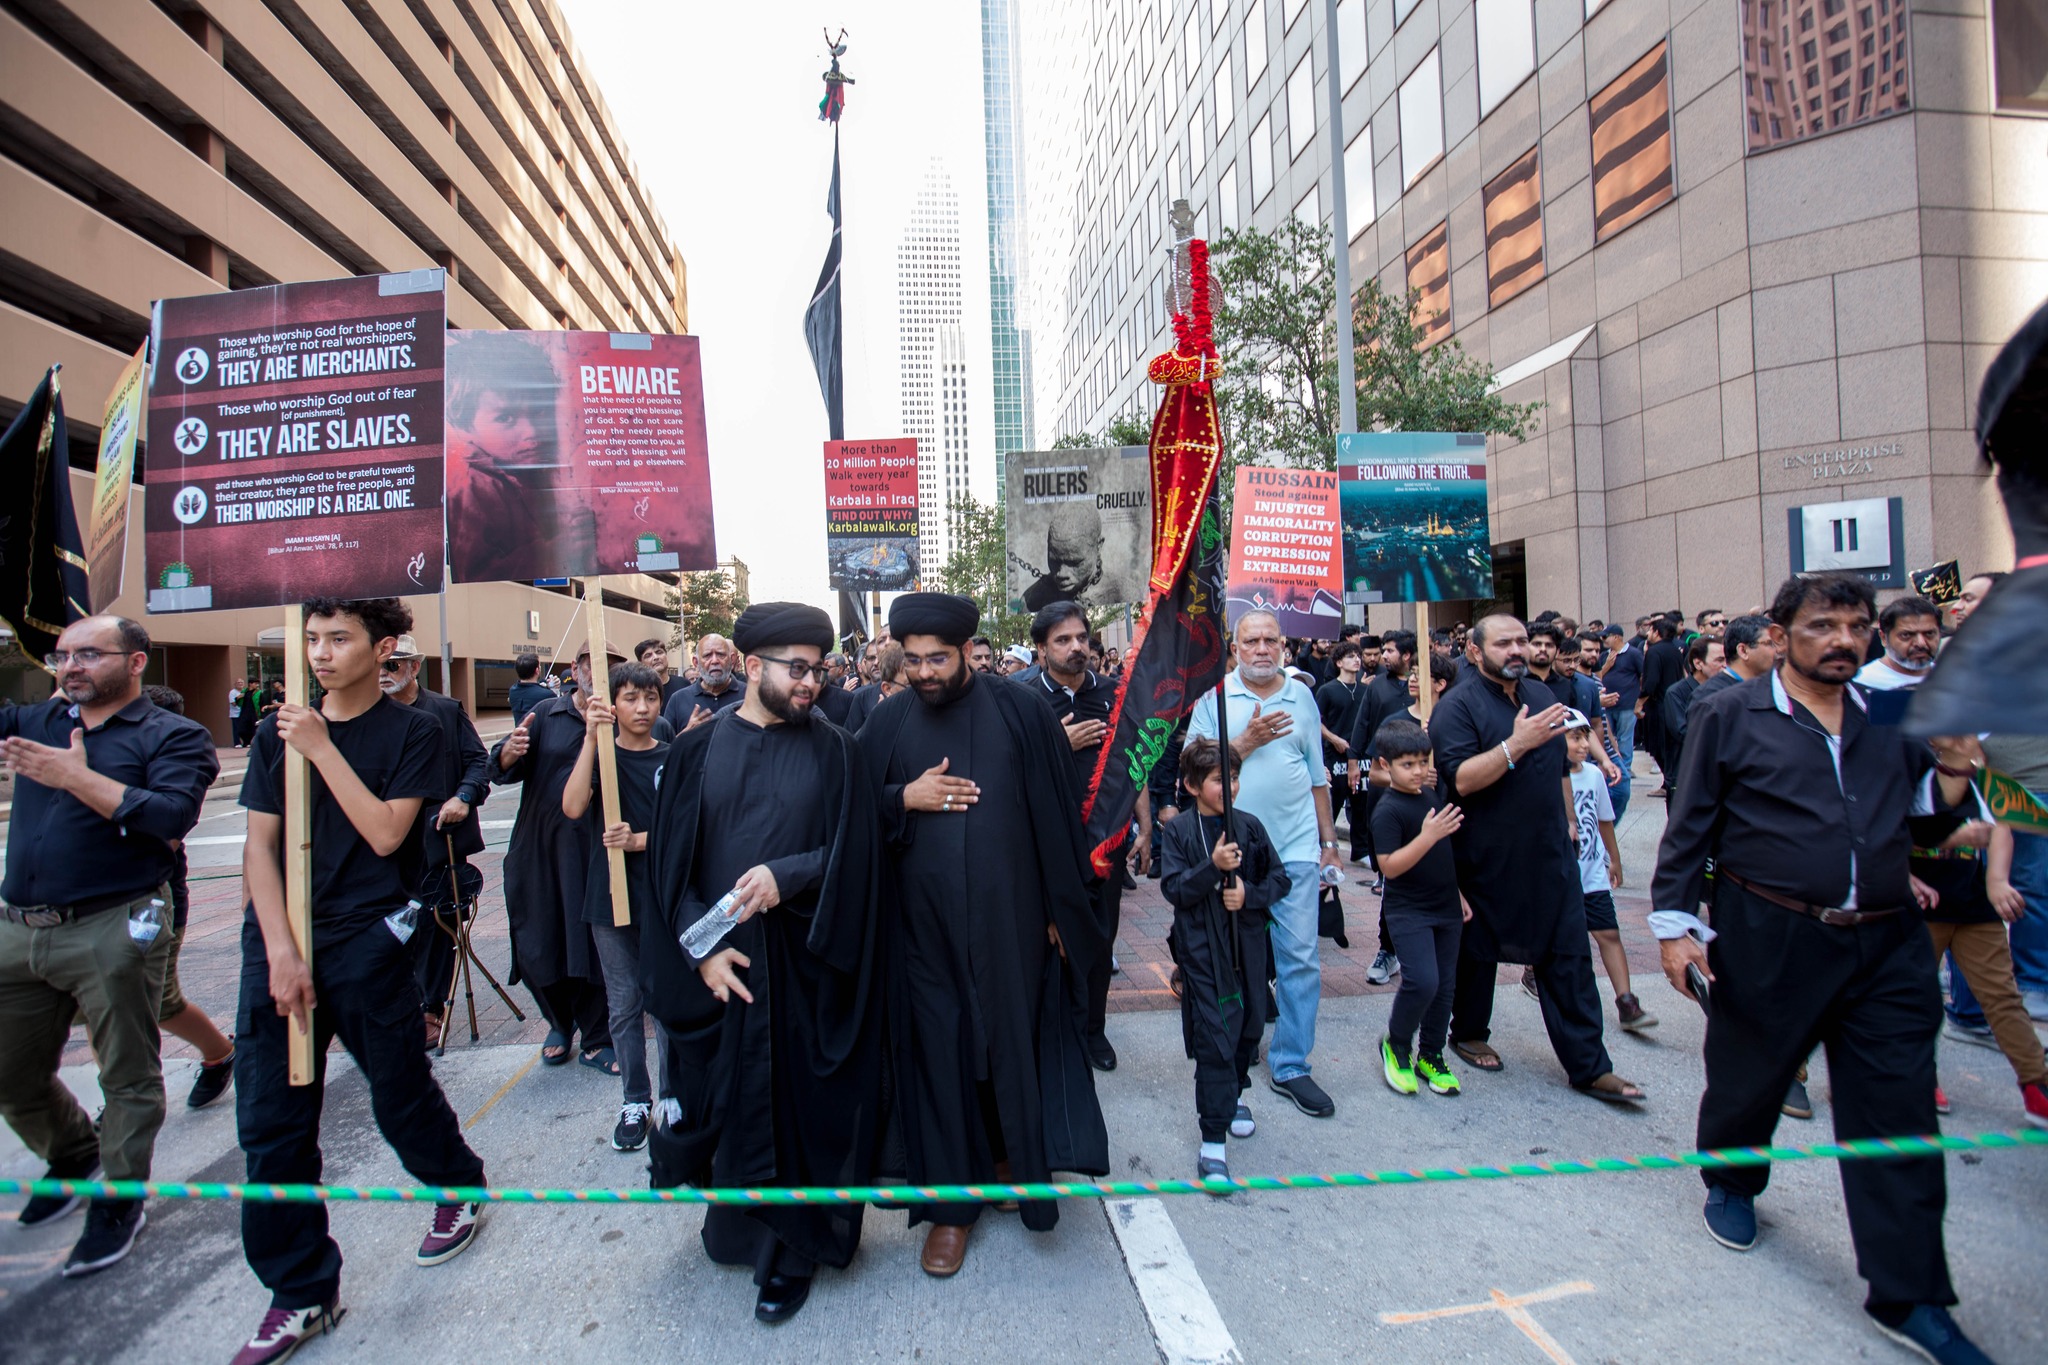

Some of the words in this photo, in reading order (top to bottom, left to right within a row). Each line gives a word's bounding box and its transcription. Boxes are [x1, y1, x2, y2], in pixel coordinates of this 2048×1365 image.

[219, 335, 247, 348] Those
[249, 332, 271, 345] who
[272, 328, 312, 346] worship
[315, 326, 336, 339] God
[339, 324, 354, 336] for
[356, 322, 373, 335] the
[376, 319, 402, 336] hope
[404, 318, 416, 330] of
[218, 344, 258, 361] gaining,
[260, 340, 297, 358] they're
[300, 338, 319, 351] not
[322, 336, 343, 349] real
[345, 329, 416, 350] worshippers,
[217, 359, 261, 387] THEY
[264, 356, 298, 383] ARE
[302, 344, 416, 379] MERCHANTS.
[580, 365, 682, 395] BEWARE
[217, 402, 251, 417] Those
[253, 400, 277, 414] who
[279, 396, 325, 414] worship
[328, 394, 352, 407] God
[355, 392, 376, 404] out
[378, 390, 391, 402] of
[392, 388, 417, 401] fear
[583, 395, 599, 403] that
[601, 396, 614, 404] the
[616, 396, 635, 404] need
[636, 396, 644, 404] of
[646, 396, 672, 406] people
[673, 397, 682, 405] to
[281, 411, 292, 422] [of
[294, 408, 345, 421] punishment],
[583, 408, 598, 416] you
[600, 406, 606, 414] is
[607, 408, 634, 416] among
[635, 406, 648, 414] the
[649, 406, 682, 417] blessings
[584, 416, 593, 424] of
[619, 417, 629, 425] So
[632, 417, 643, 425] do
[647, 417, 660, 425] not
[217, 427, 271, 461] THEY
[277, 422, 321, 455] ARE
[326, 414, 416, 451] SLAVES.
[585, 429, 607, 437] away
[610, 427, 625, 435] the
[628, 427, 653, 437] needy
[657, 427, 684, 437] people
[586, 437, 608, 445] when
[609, 437, 627, 447] they
[650, 437, 658, 445] to
[587, 448, 601, 456] the
[605, 448, 628, 456] God's
[632, 447, 668, 458] blessings
[672, 447, 686, 456] will
[841, 446, 866, 455] More
[871, 445, 896, 454] than
[1783, 444, 1903, 469] ENTERPRISE
[588, 458, 612, 466] return
[616, 458, 630, 466] and
[633, 460, 643, 468] go
[646, 458, 687, 466] elsewhere.
[827, 459, 839, 469] 20
[844, 457, 876, 469] Million
[881, 456, 915, 469] People
[215, 480, 230, 490] and
[231, 478, 254, 489] those
[255, 476, 272, 487] who
[273, 474, 305, 487] worship
[306, 472, 324, 482] God
[325, 471, 335, 481] to
[336, 470, 347, 480] be
[348, 467, 380, 481] grateful
[381, 464, 415, 476] towards
[830, 471, 852, 480] Walk
[857, 472, 883, 481] every
[888, 472, 909, 481] year
[1358, 465, 1416, 480] FOLLOWING
[1418, 465, 1437, 480] THE
[1438, 465, 1471, 480] TRUTH.
[1813, 461, 1873, 480] PLAZA
[216, 489, 237, 502] their
[239, 486, 274, 502] creator,
[276, 484, 297, 500] they
[299, 486, 315, 495] are
[317, 481, 334, 493] the
[336, 479, 356, 492] free
[359, 476, 394, 492] people,
[397, 474, 415, 486] and
[850, 482, 889, 492] towards
[1024, 472, 1088, 497] RULERS
[1248, 471, 1336, 490] HUSSAIN
[829, 494, 871, 506] Karbala
[877, 493, 886, 505] in
[892, 493, 914, 507] Iraq
[1096, 491, 1146, 510] CRUELLY.
[1255, 489, 1284, 498] Stood
[1288, 491, 1329, 501] against
[215, 503, 252, 524] THEIR
[255, 498, 315, 521] WORSHIP
[318, 496, 331, 515] IS
[334, 495, 344, 514] A
[347, 492, 381, 513] REAL
[384, 489, 415, 510] ONE.
[1255, 501, 1325, 516] INJUSTICE
[832, 511, 857, 521] FIND
[859, 511, 880, 521] OUT
[882, 510, 912, 520] WHY?
[828, 521, 917, 535] Karbalawalk.org
[1243, 515, 1336, 532] IMMORALITY
[305, 535, 330, 543] HUSAYN
[1243, 530, 1333, 547] CORRUPTION
[1244, 545, 1330, 561] OPPRESSION
[1243, 560, 1328, 576] EXTREMISM
